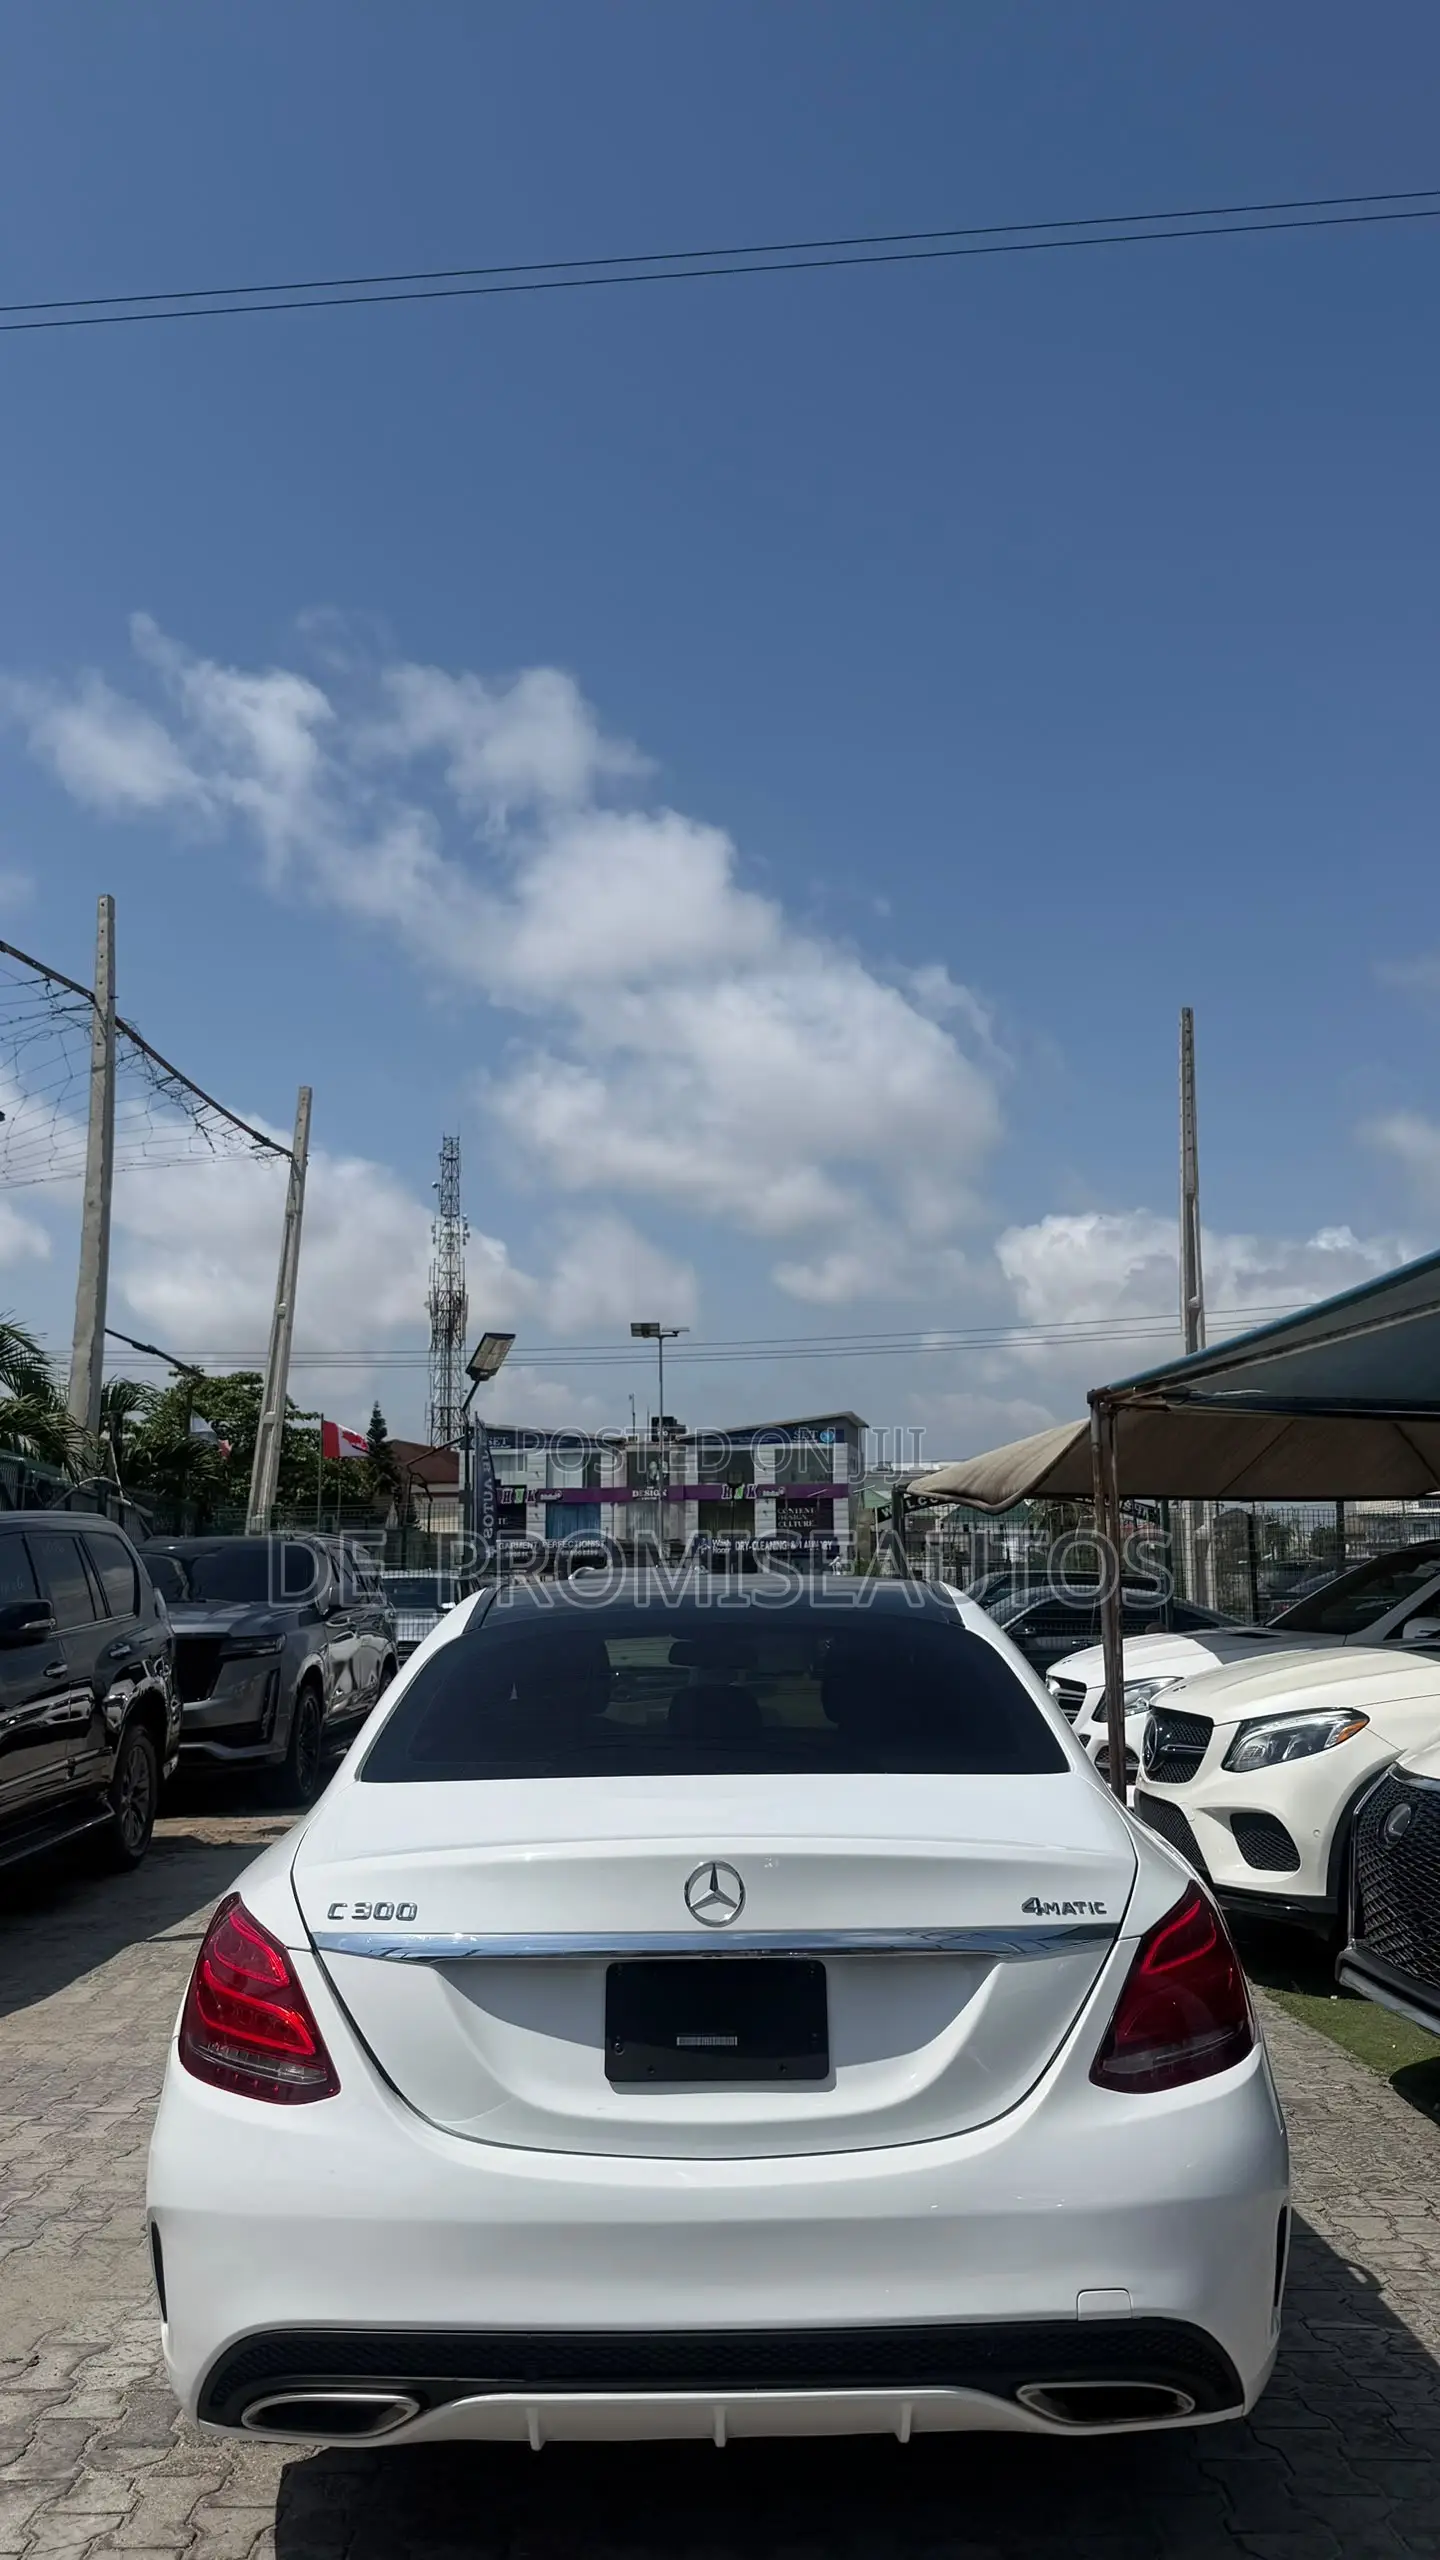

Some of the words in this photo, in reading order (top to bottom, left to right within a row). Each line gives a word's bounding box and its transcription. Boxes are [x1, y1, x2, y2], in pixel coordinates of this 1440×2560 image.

[327, 1902, 348, 1920] C
[351, 1901, 418, 1921] 300
[1021, 1896, 1107, 1916] 4MATIC
